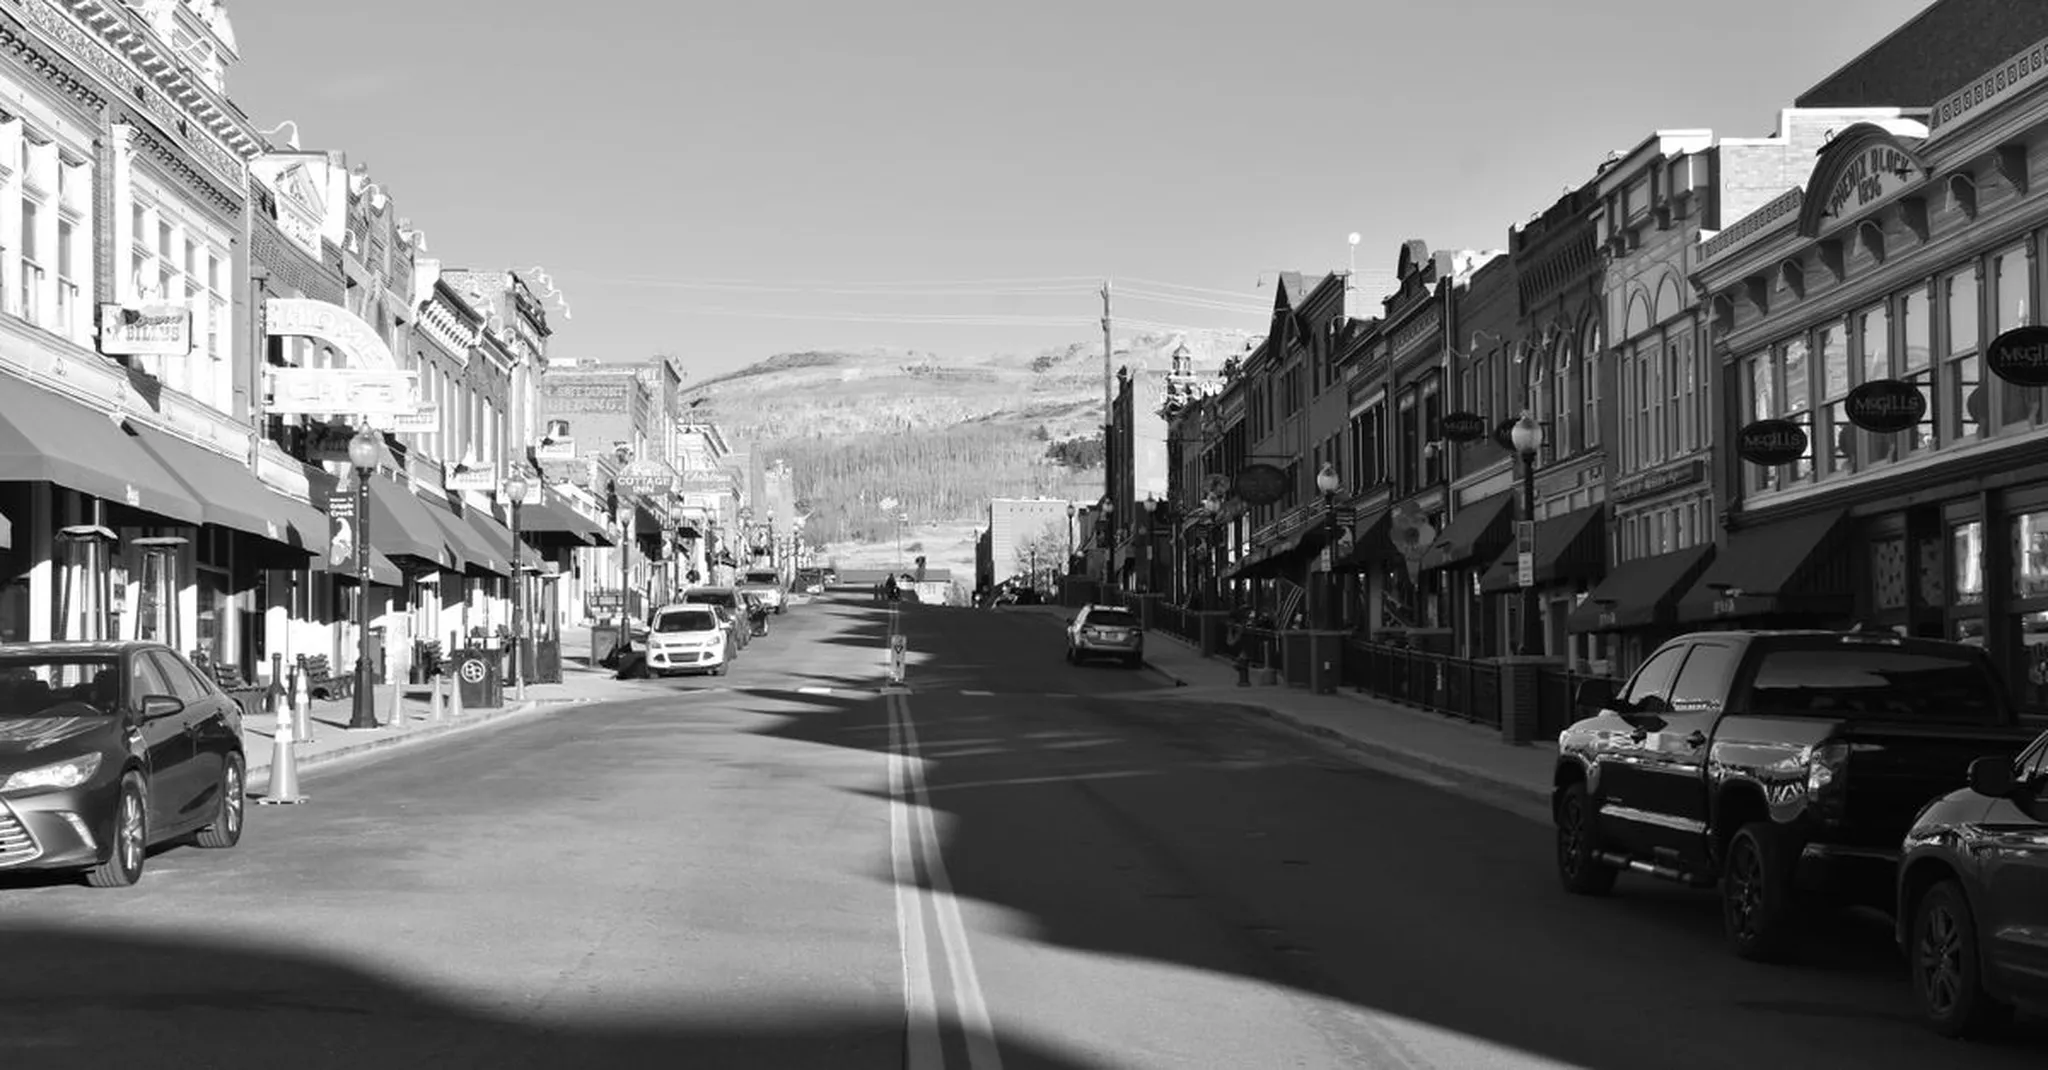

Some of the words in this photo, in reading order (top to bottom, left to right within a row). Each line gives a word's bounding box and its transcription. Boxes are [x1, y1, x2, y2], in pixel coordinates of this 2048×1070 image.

[1870, 148, 1909, 182] BLOCK
[1856, 174, 1881, 206] 1896
[617, 476, 671, 487] COTTAGE
